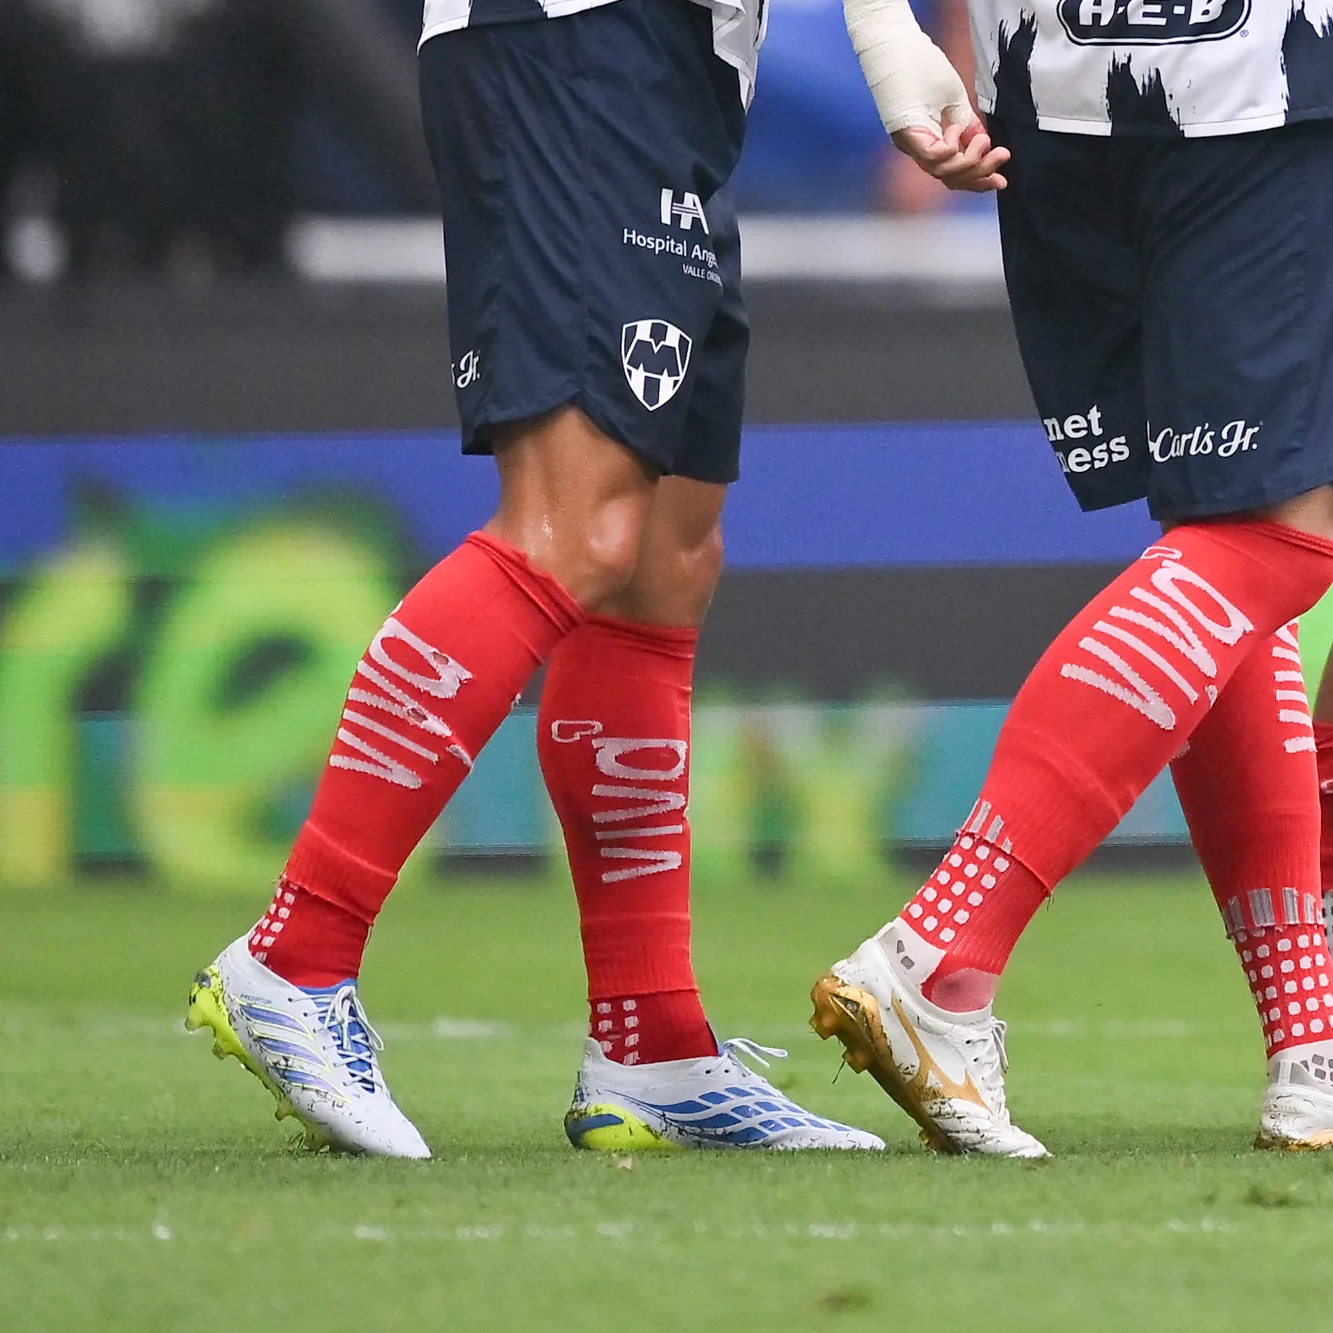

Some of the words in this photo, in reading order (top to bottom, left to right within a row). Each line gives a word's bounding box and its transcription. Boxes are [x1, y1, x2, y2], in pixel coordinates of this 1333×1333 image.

[623, 228, 688, 257] Hospital
[1152, 422, 1216, 463] Carl's
[1217, 419, 1260, 457] Jr.
